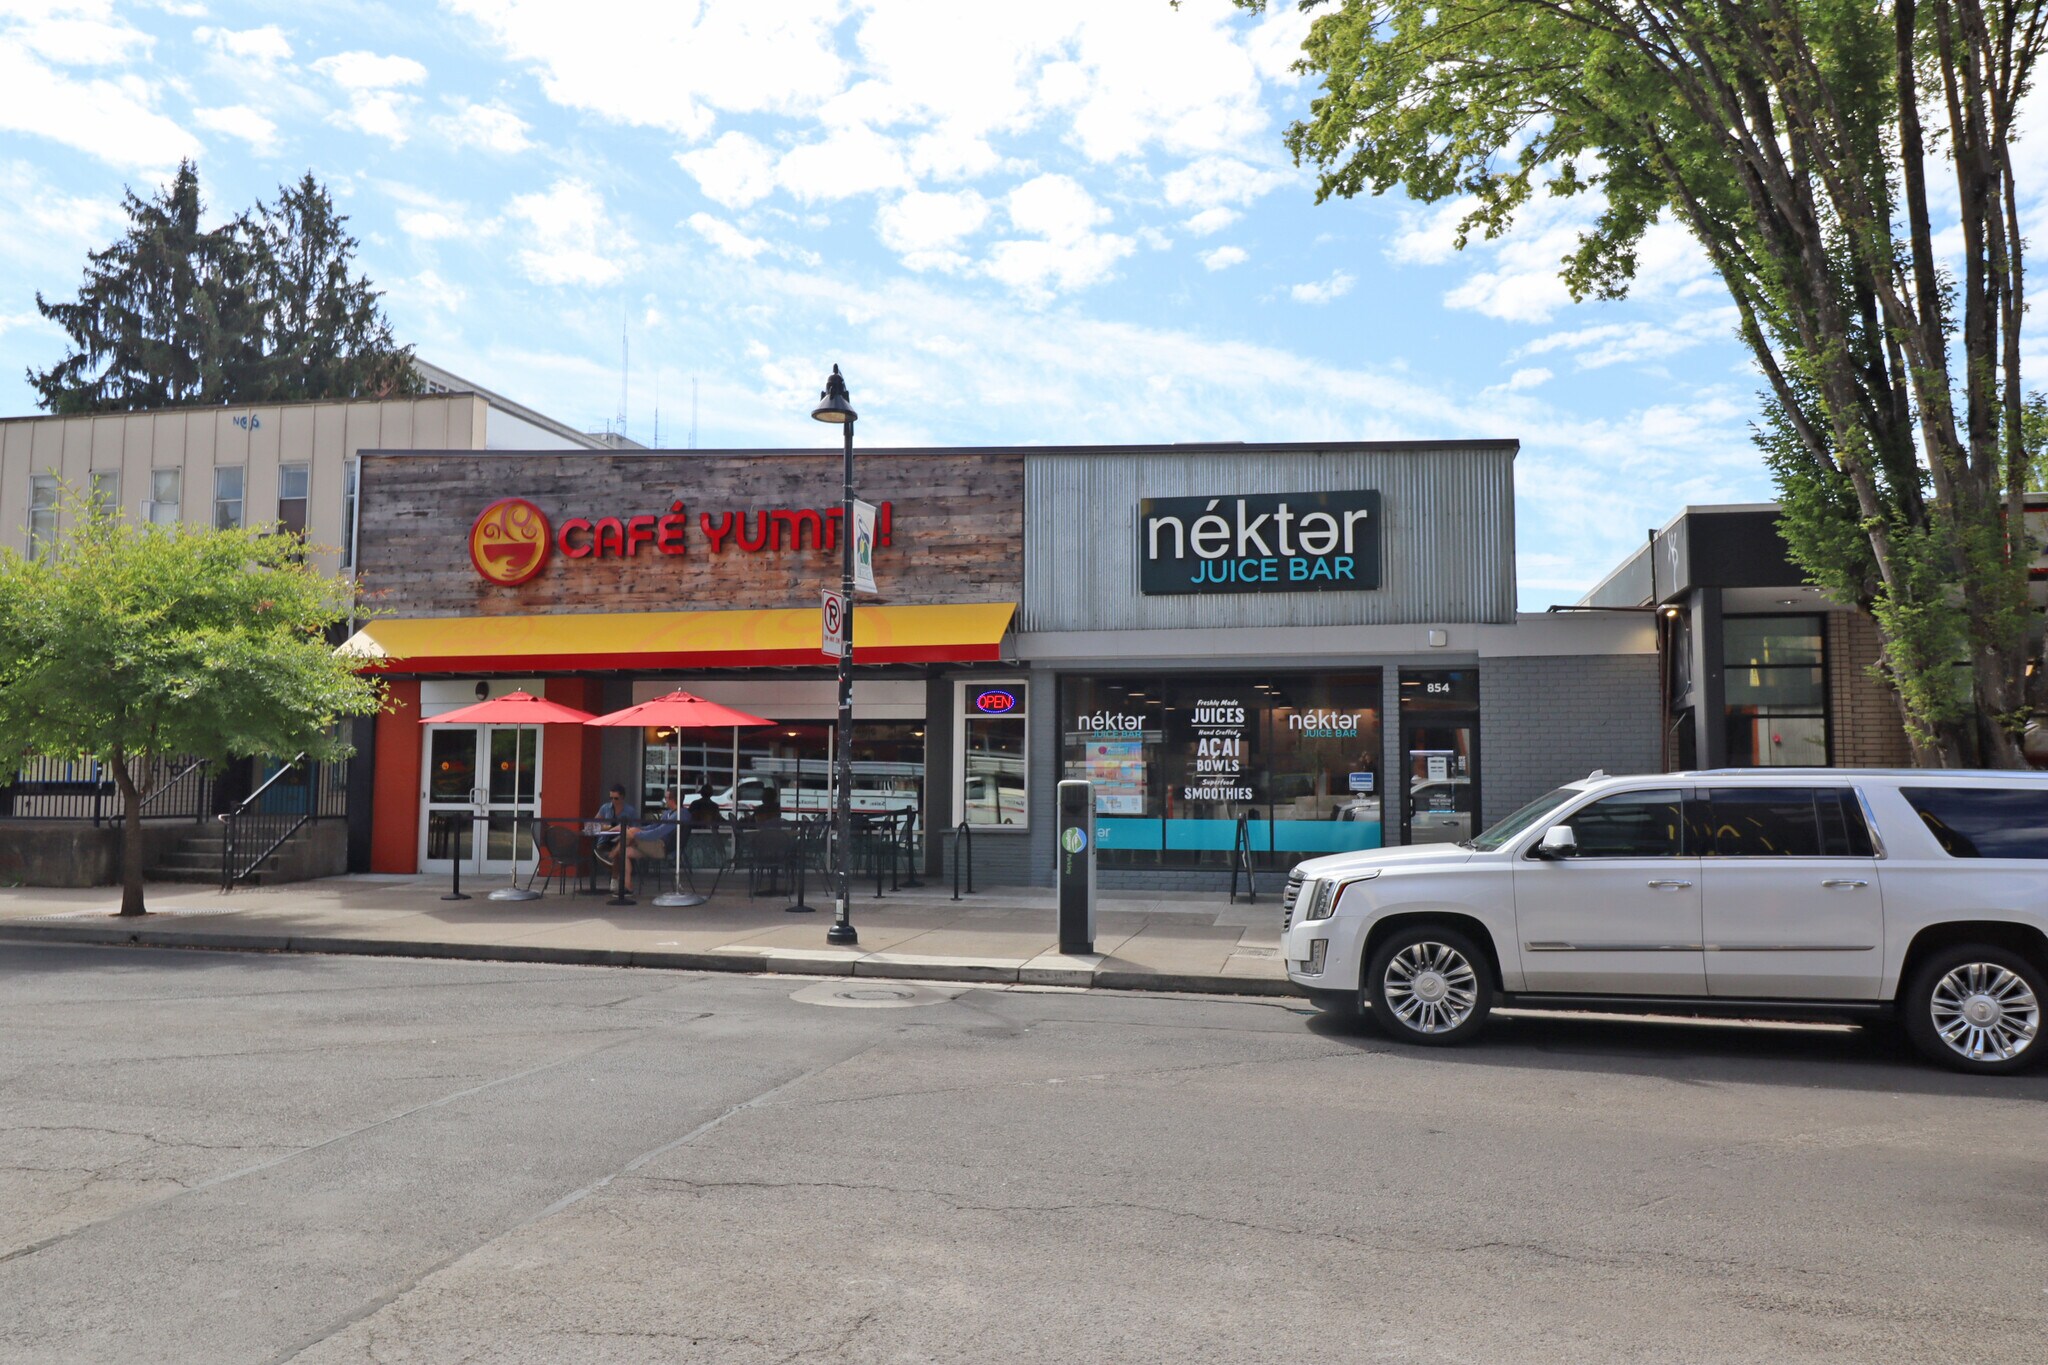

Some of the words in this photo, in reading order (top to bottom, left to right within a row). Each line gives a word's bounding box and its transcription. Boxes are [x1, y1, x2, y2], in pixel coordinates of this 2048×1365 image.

[557, 500, 687, 559] CAFÉ
[1148, 498, 1367, 560] néktər
[1190, 558, 1278, 584] JUICE
[1289, 556, 1355, 581] BAR
[1427, 683, 1450, 693] 854
[978, 695, 1011, 709] OPEN
[1196, 699, 1220, 707] Freshly
[1078, 710, 1146, 730] néktər
[1191, 707, 1245, 723] JUICES
[1289, 709, 1362, 730] néktər
[1092, 730, 1119, 738] JUICE
[1121, 730, 1142, 738] BAR
[1304, 729, 1333, 738] JUICE
[1335, 729, 1357, 738] BAR
[1197, 732, 1241, 759] AÇAÍ
[1197, 759, 1240, 772] BOWLS
[1201, 778, 1235, 786] Superfood
[1184, 787, 1253, 800] SMOOTHIES
